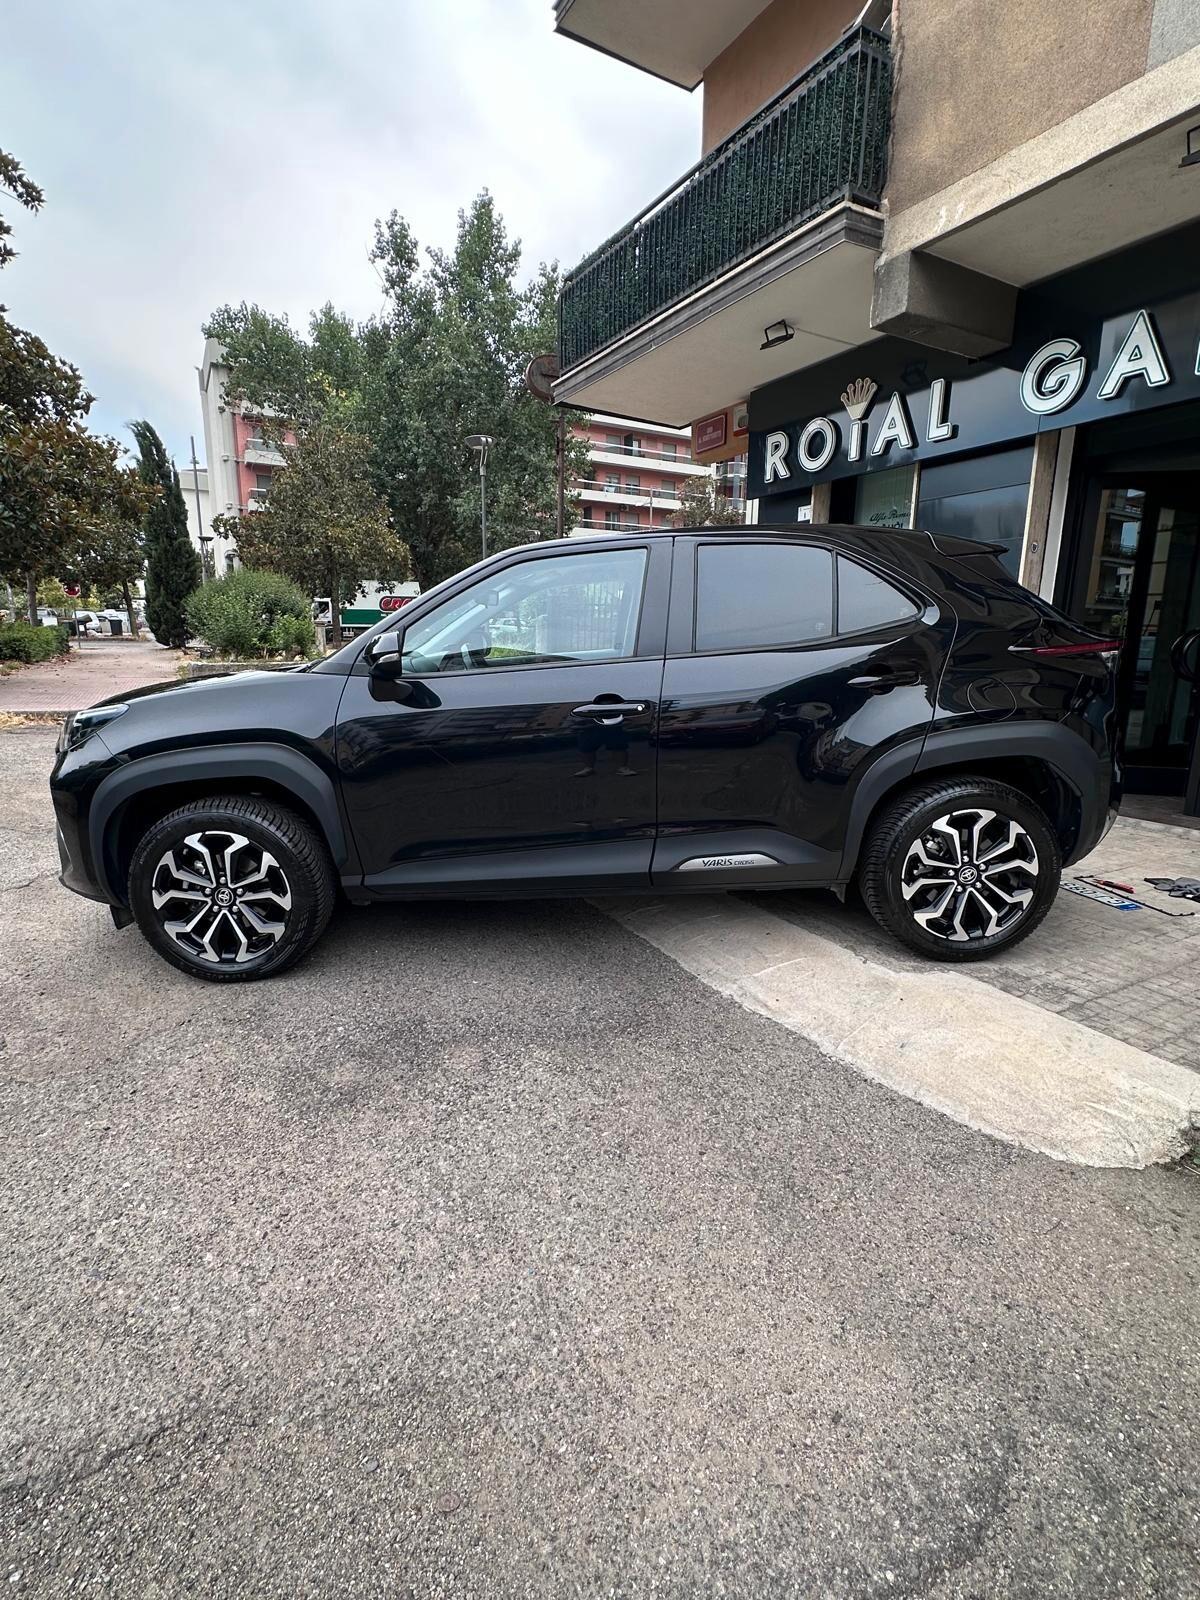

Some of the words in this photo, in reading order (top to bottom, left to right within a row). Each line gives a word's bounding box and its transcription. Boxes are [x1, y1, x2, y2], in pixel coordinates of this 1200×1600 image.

[764, 377, 954, 484] ROYAL
[1018, 309, 1200, 416] GA
[702, 858, 733, 867] YARIS
